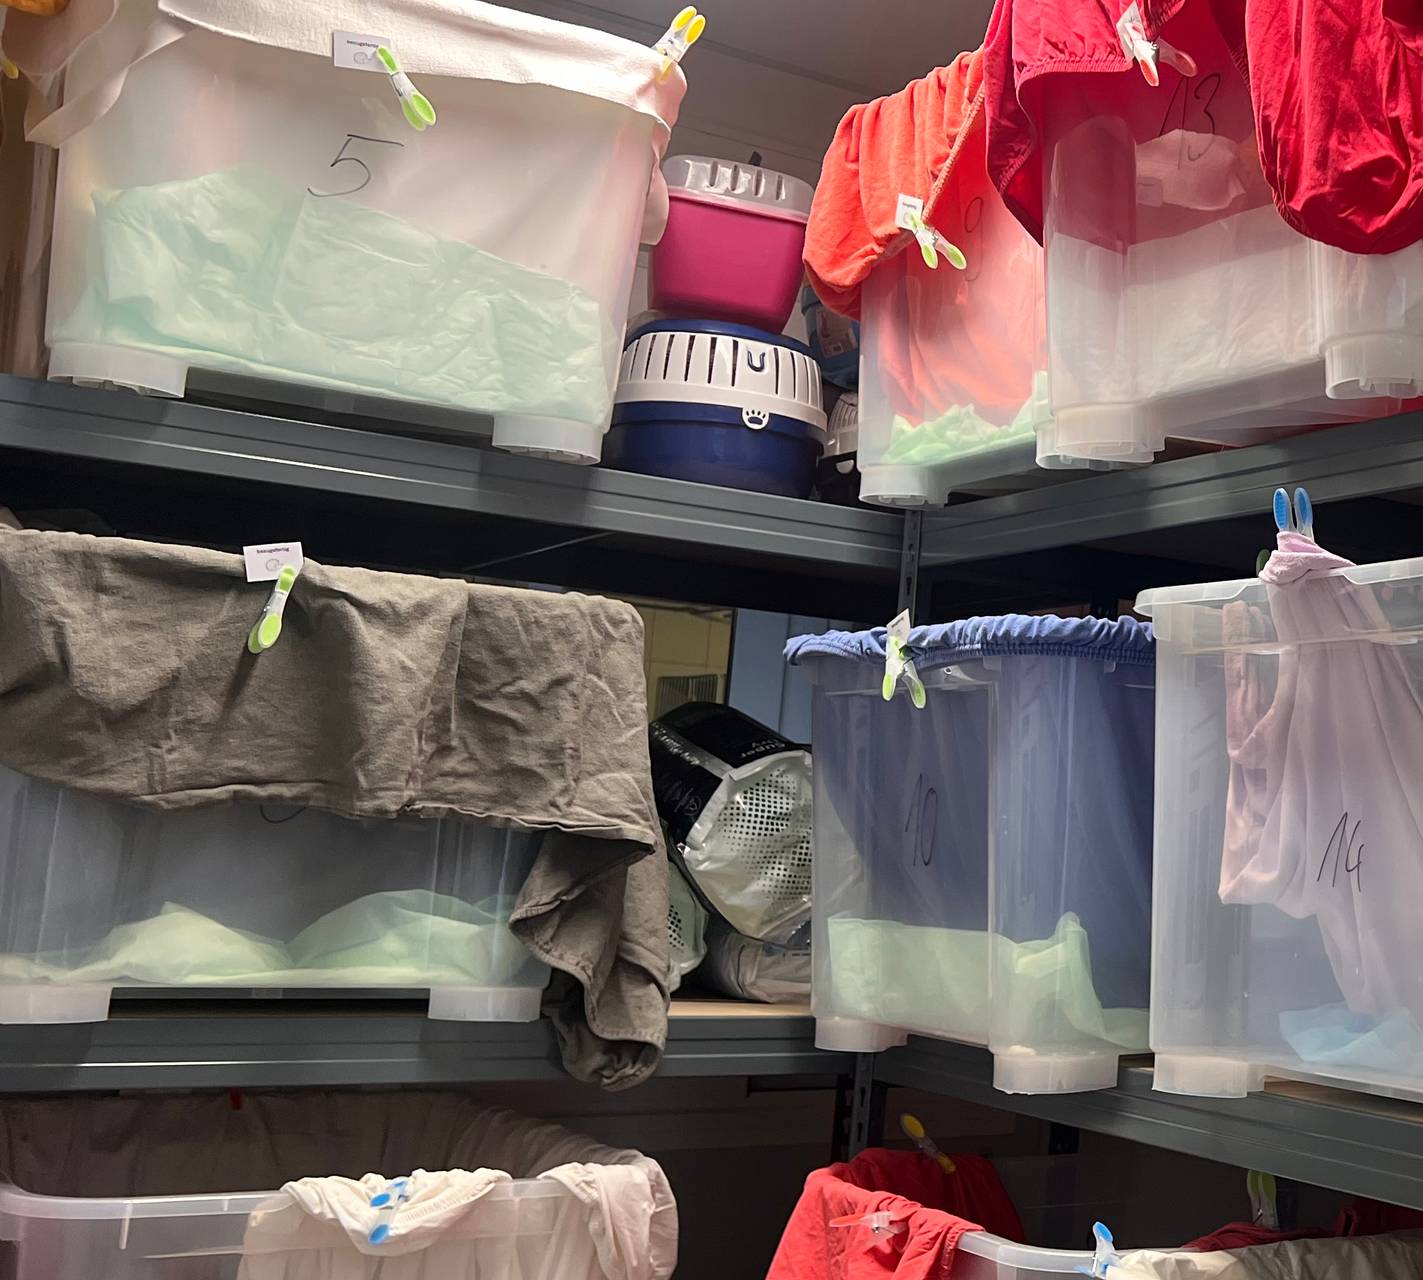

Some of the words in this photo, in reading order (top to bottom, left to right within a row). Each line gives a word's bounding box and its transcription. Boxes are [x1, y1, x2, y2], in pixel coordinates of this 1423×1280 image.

[1159, 72, 1222, 170] 13
[306, 133, 405, 198] 5
[964, 196, 984, 282] 9
[904, 772, 939, 867] 10
[1316, 811, 1365, 893] 14
